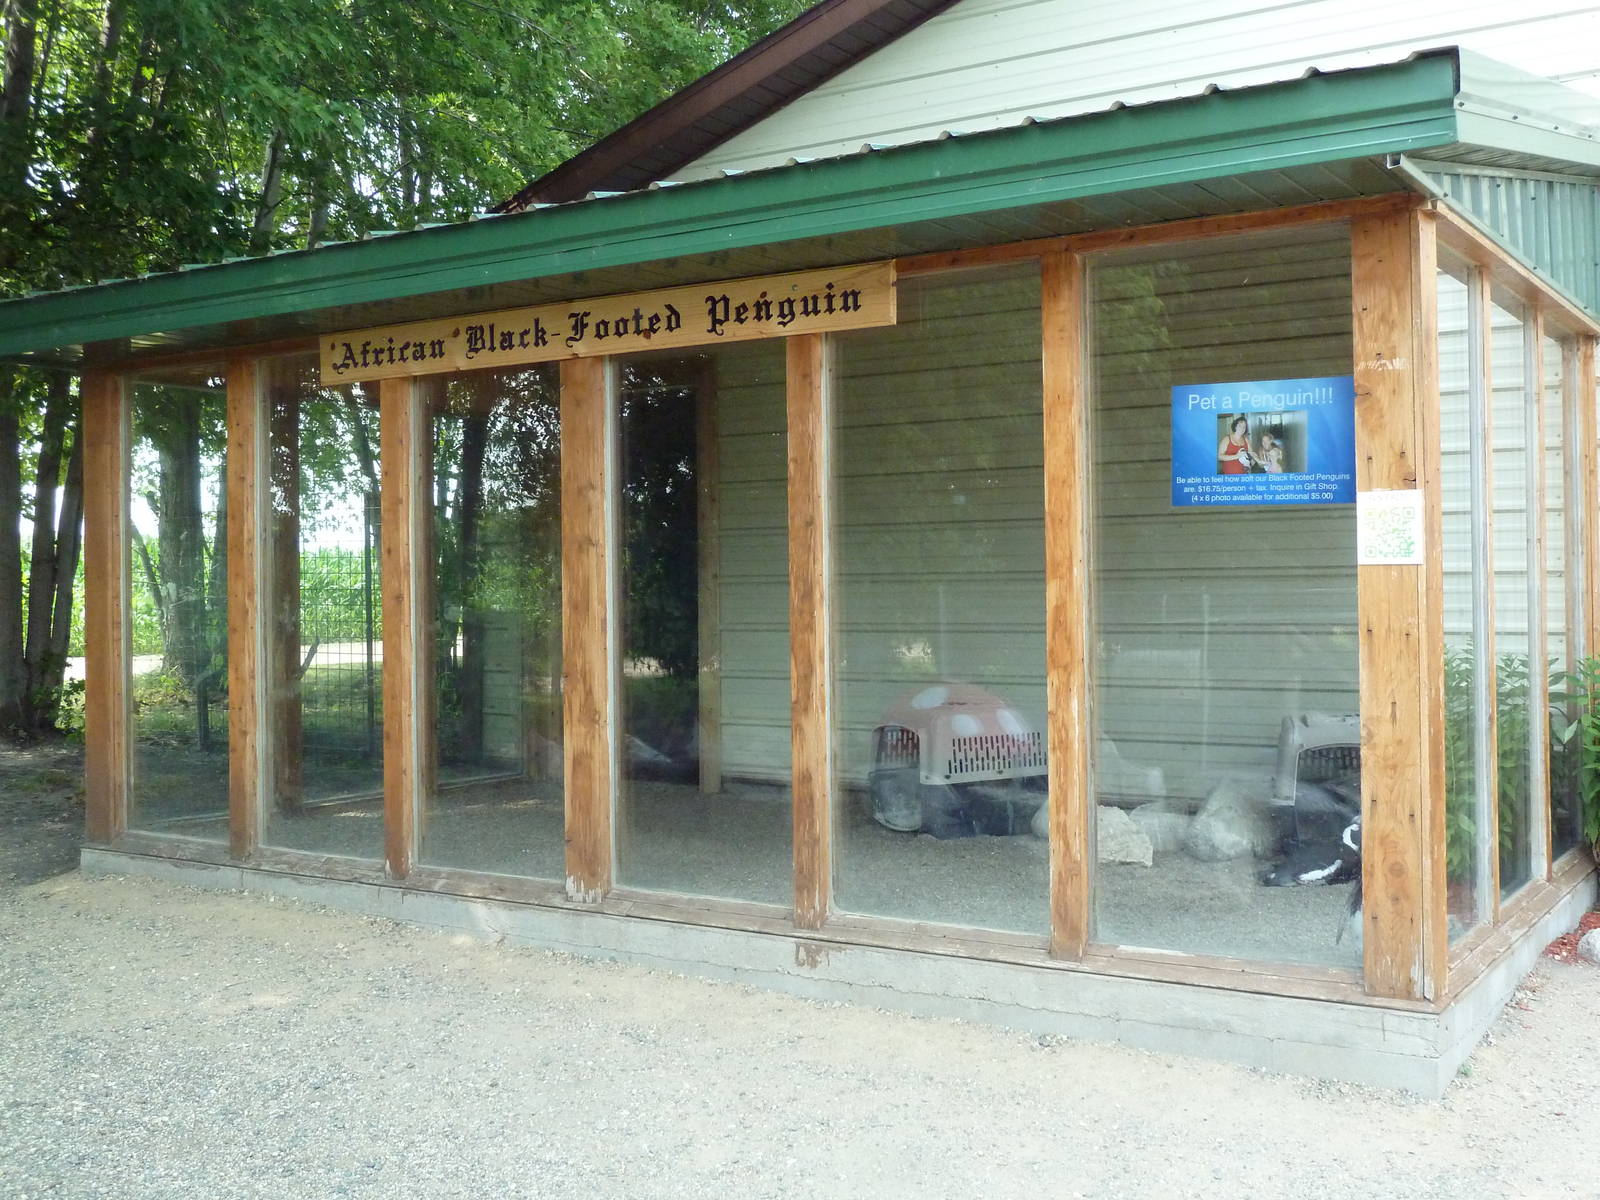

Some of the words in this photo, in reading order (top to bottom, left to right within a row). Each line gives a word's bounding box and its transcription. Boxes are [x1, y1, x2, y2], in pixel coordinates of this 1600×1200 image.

[332, 338, 446, 375] African
[465, 303, 682, 360] Black-Footed
[704, 282, 862, 337] Penguin
[1188, 393, 1217, 410] Pet
[1222, 397, 1233, 409] a
[1239, 387, 1333, 410] Penguin!!!
[1176, 476, 1186, 484] Be
[1187, 476, 1201, 484] able
[1225, 475, 1239, 483] how
[1240, 475, 1254, 483] soft
[1289, 473, 1315, 481] Footed
[1316, 473, 1351, 481] Penguins
[1270, 483, 1295, 492] Inquire
[1295, 483, 1303, 491] in
[1191, 494, 1198, 503] (4
[1211, 494, 1232, 503] photo
[1232, 493, 1262, 501] available
[1274, 492, 1310, 500] additional
[1310, 491, 1334, 501] $5.00)
